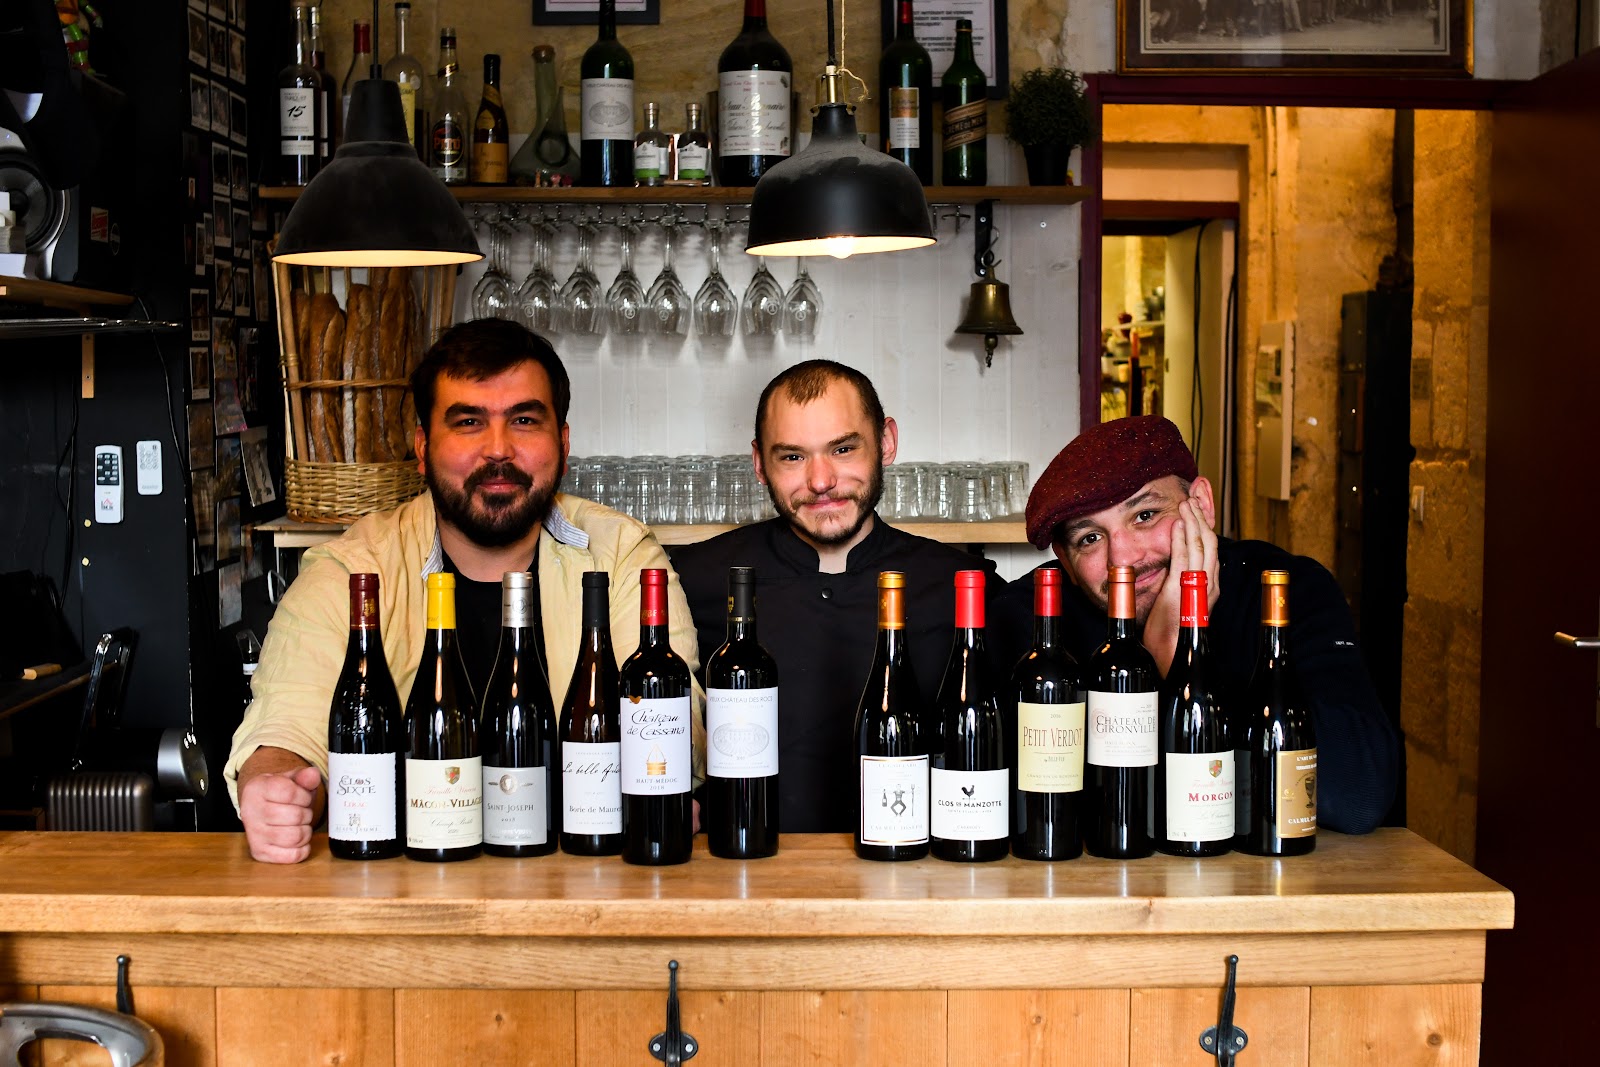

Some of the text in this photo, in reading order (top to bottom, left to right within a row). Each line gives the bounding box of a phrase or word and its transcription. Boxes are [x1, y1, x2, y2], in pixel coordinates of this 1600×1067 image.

[287, 105, 307, 118] 15
[1096, 714, 1156, 726] CHÂTEAU DE
[626, 725, 639, 735] de
[1096, 723, 1156, 734] GIRONVILLE
[1023, 726, 1082, 748] PETIT VERDOT
[336, 780, 378, 796] SIXTE
[937, 799, 954, 807] CLOS
[963, 800, 1002, 808] MANZOTTE
